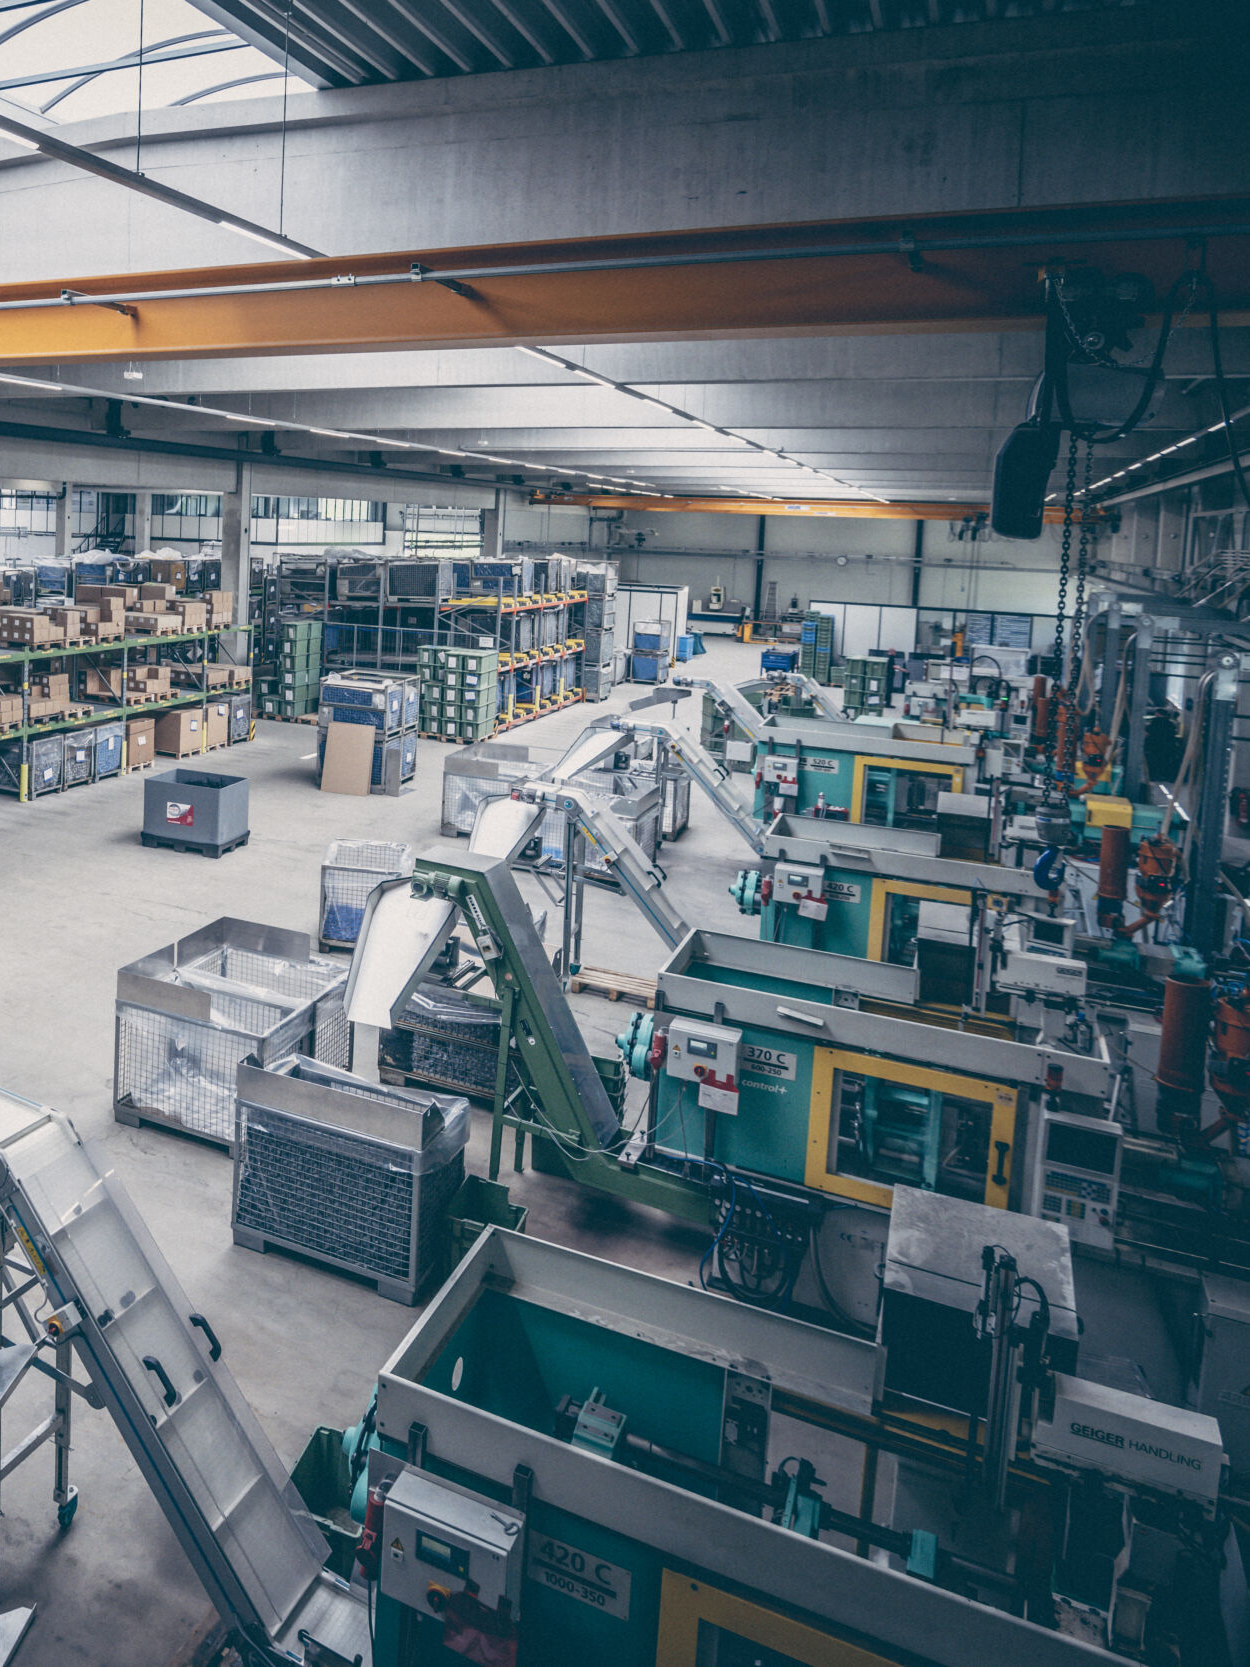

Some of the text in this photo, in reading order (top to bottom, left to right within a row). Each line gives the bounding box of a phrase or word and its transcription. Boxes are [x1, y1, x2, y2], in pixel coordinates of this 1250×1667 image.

[846, 885, 854, 893] C
[747, 1046, 786, 1065] 370 C
[751, 1063, 782, 1076] 600-250
[742, 1079, 788, 1095] control+
[1070, 1422, 1202, 1471] GEIGER HANDLING
[540, 1541, 613, 1586] 420 C
[544, 1571, 606, 1607] 1000-350
